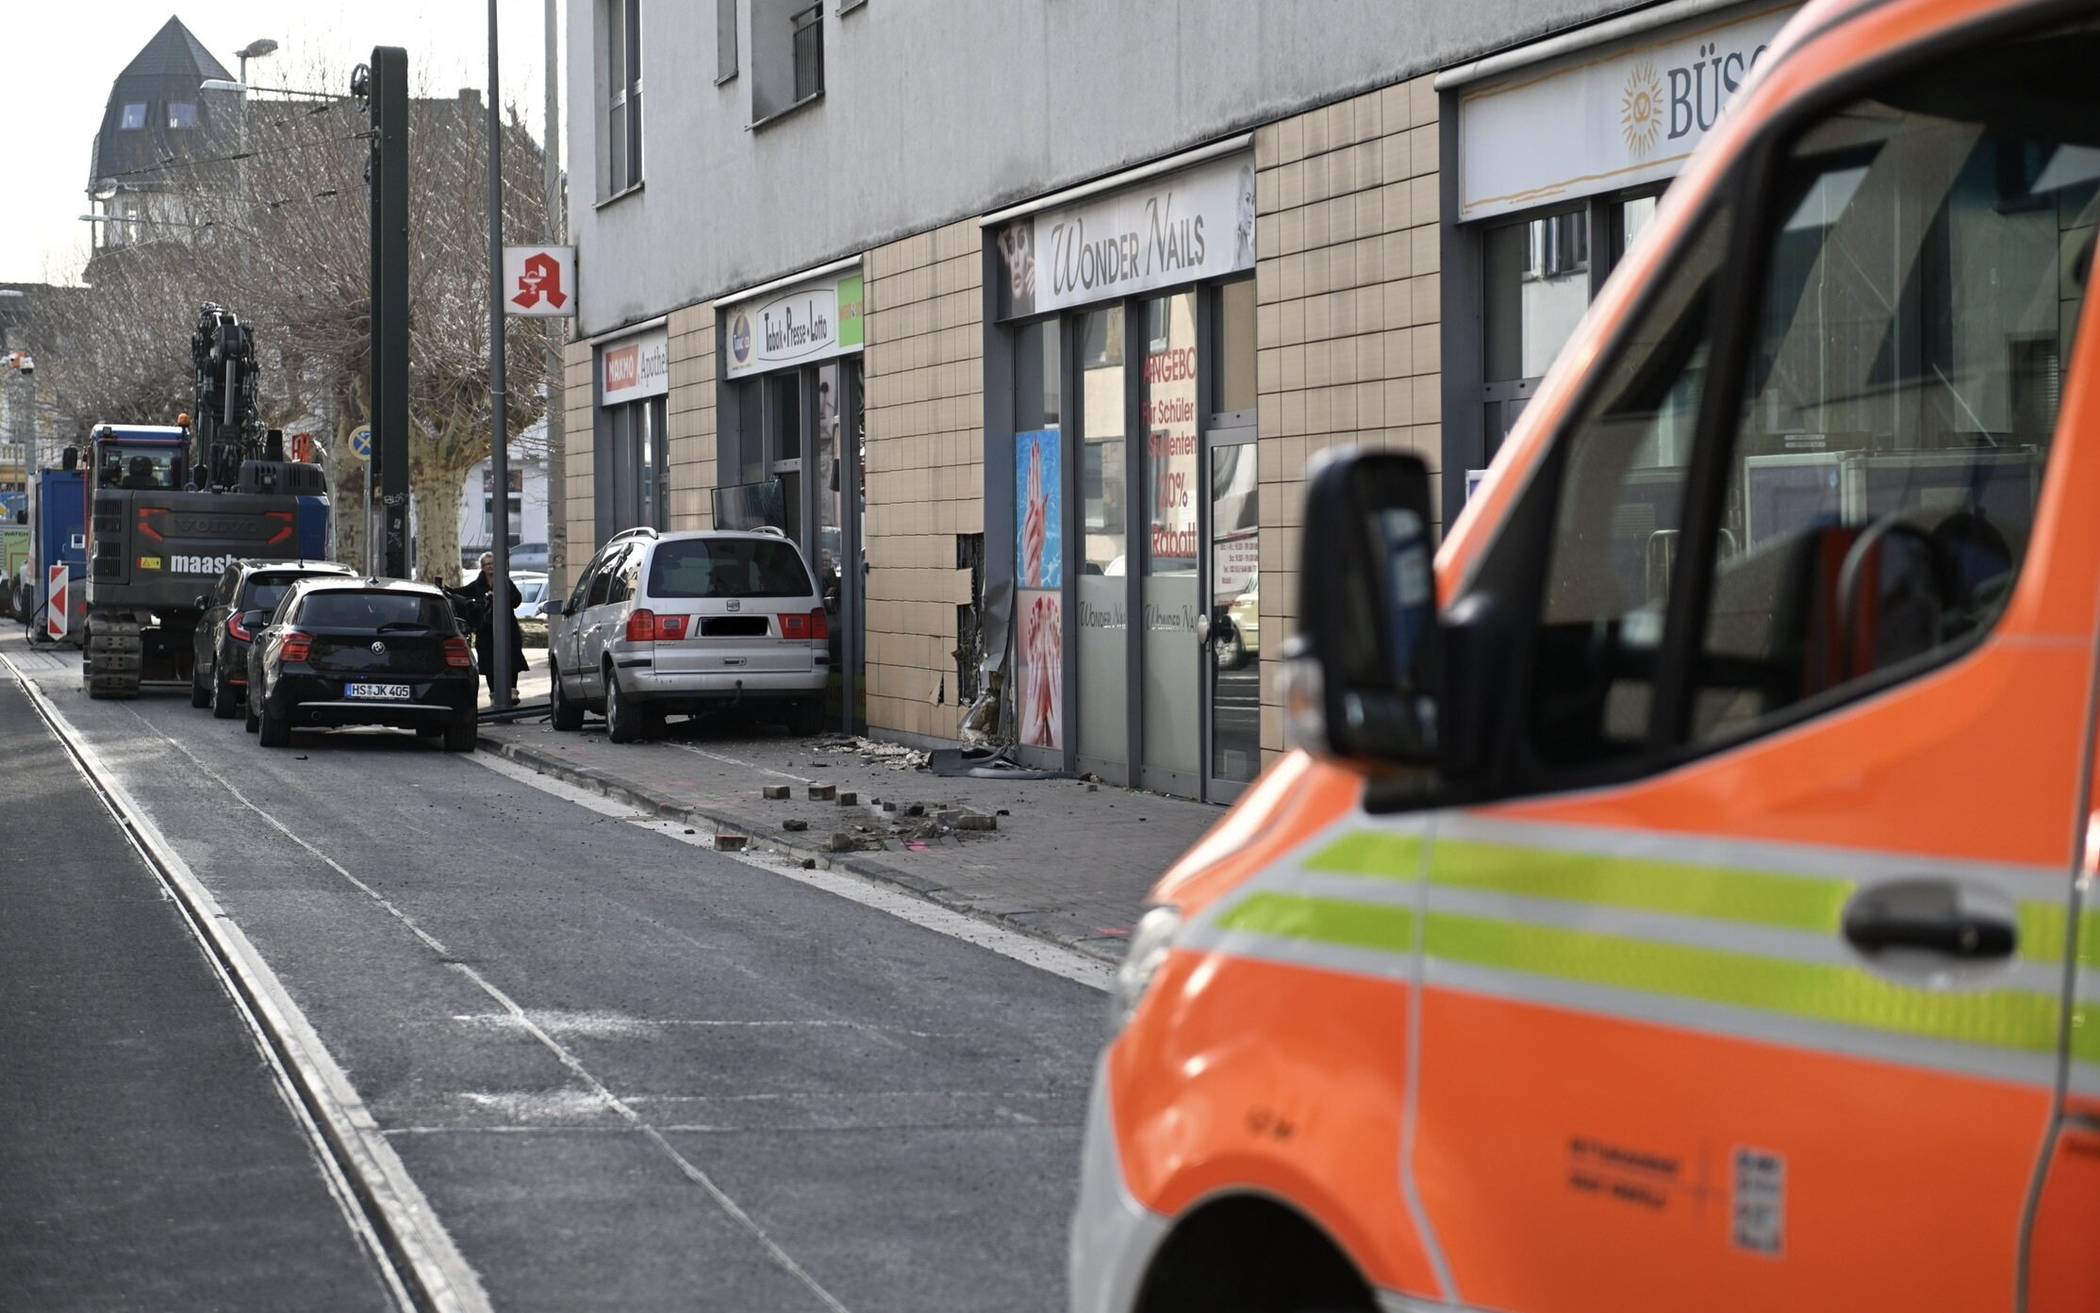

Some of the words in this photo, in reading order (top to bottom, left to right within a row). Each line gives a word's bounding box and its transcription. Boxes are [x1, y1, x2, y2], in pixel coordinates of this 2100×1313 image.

[1158, 397, 1194, 424] Schüler
[1151, 521, 1197, 557] Rabatt
[352, 684, 367, 696] HS
[373, 685, 387, 697] JK
[389, 686, 410, 697] 405
